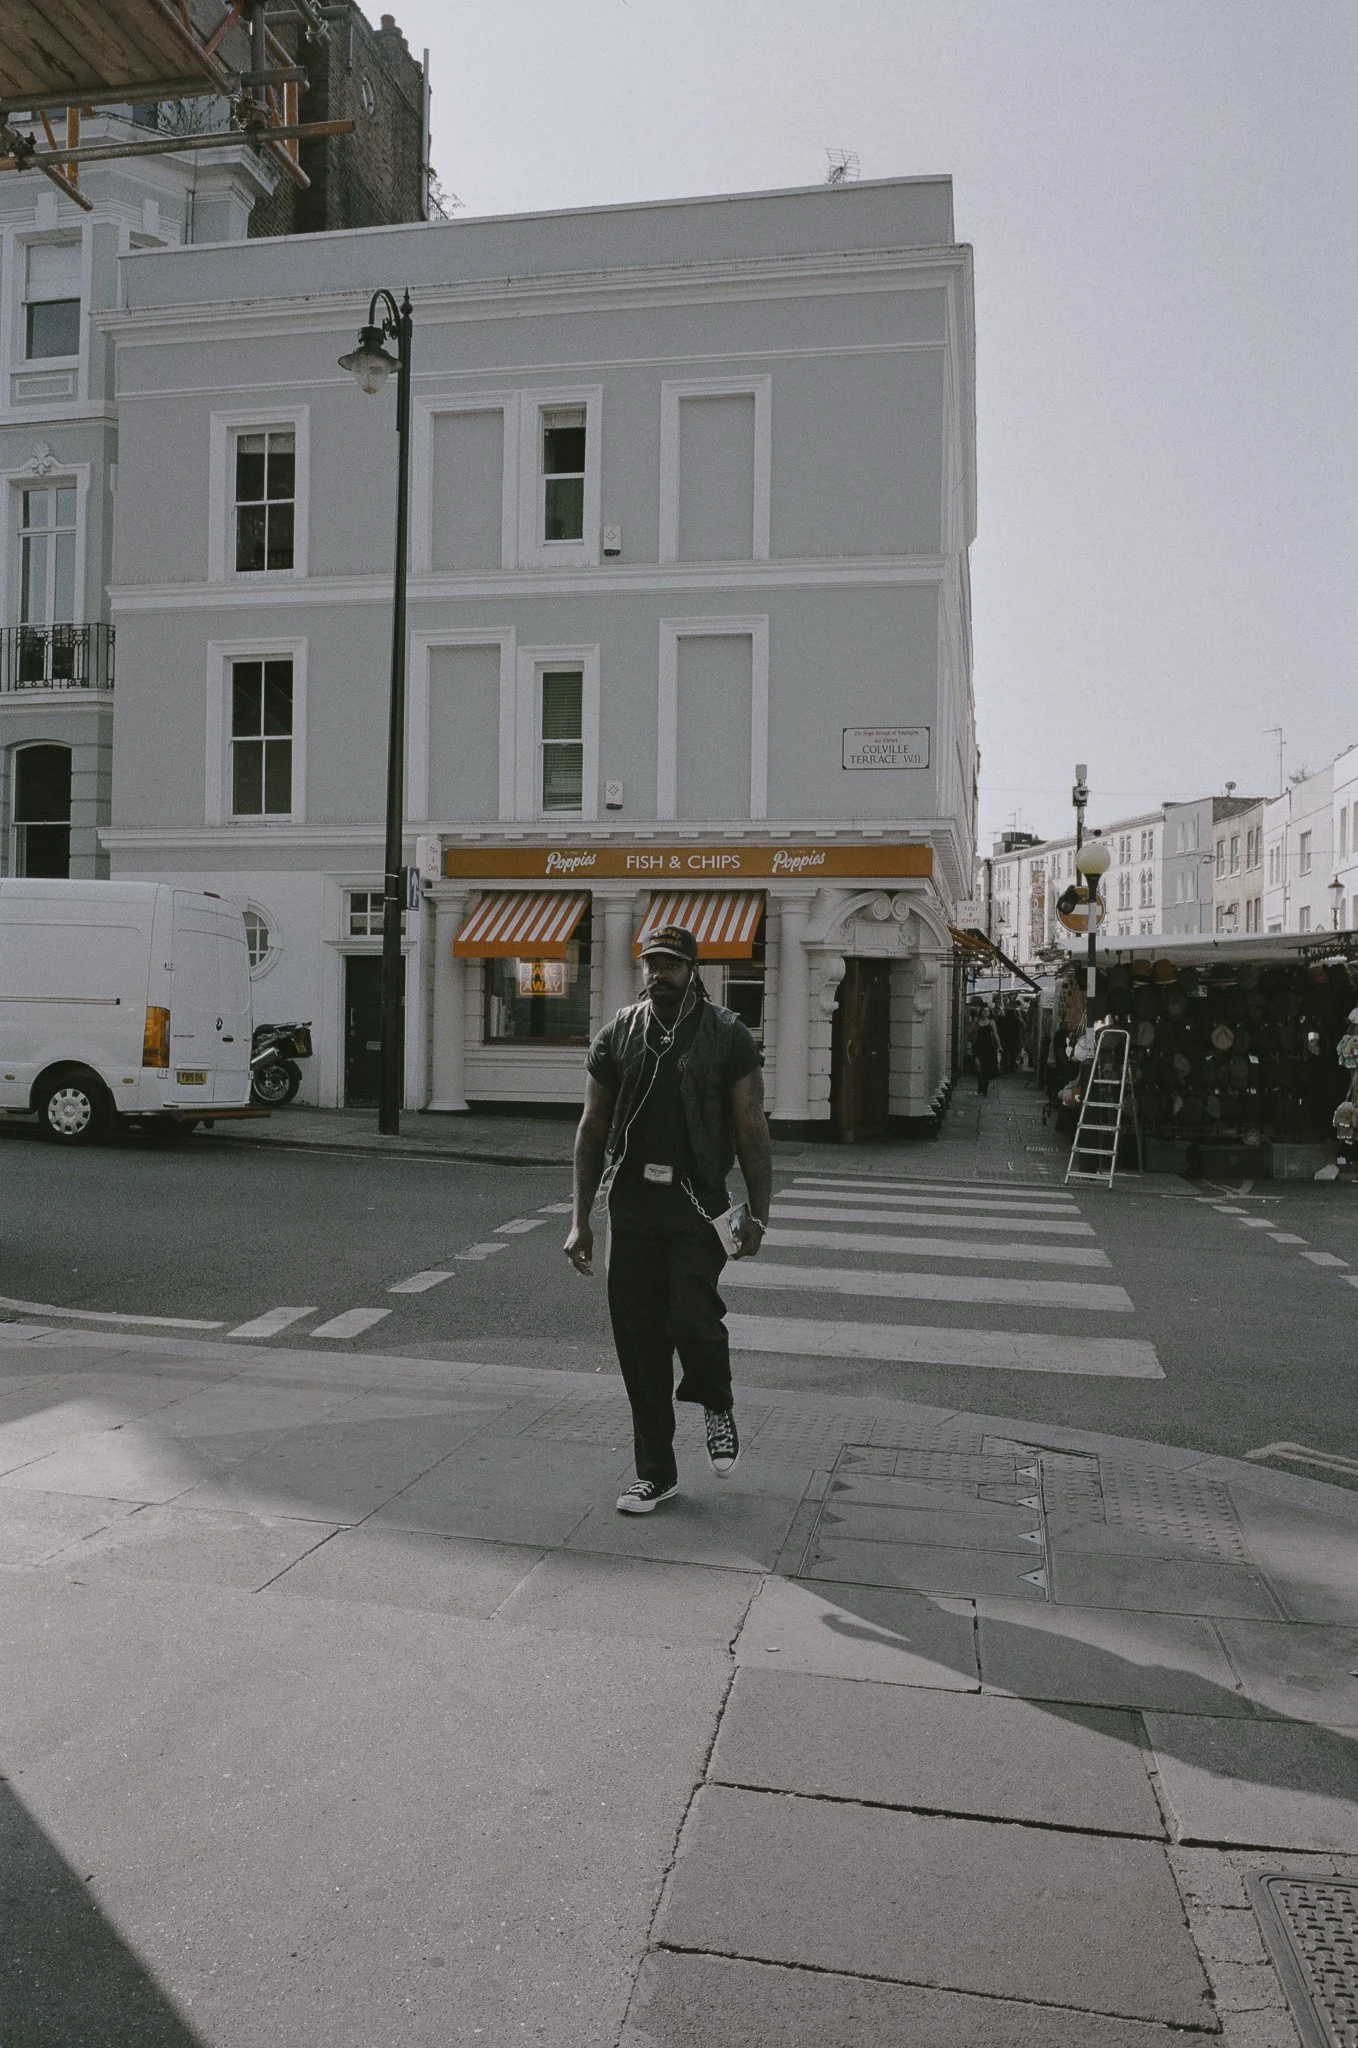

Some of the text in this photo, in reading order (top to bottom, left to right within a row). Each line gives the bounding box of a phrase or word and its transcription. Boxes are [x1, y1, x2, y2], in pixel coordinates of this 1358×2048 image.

[862, 744, 909, 754] COLVILLE
[850, 755, 897, 764] TERRACE
[545, 851, 597, 874] Poppies
[626, 855, 740, 869] FISH & CHIPS
[772, 849, 826, 873] Poppies
[523, 981, 560, 992] AWAY
